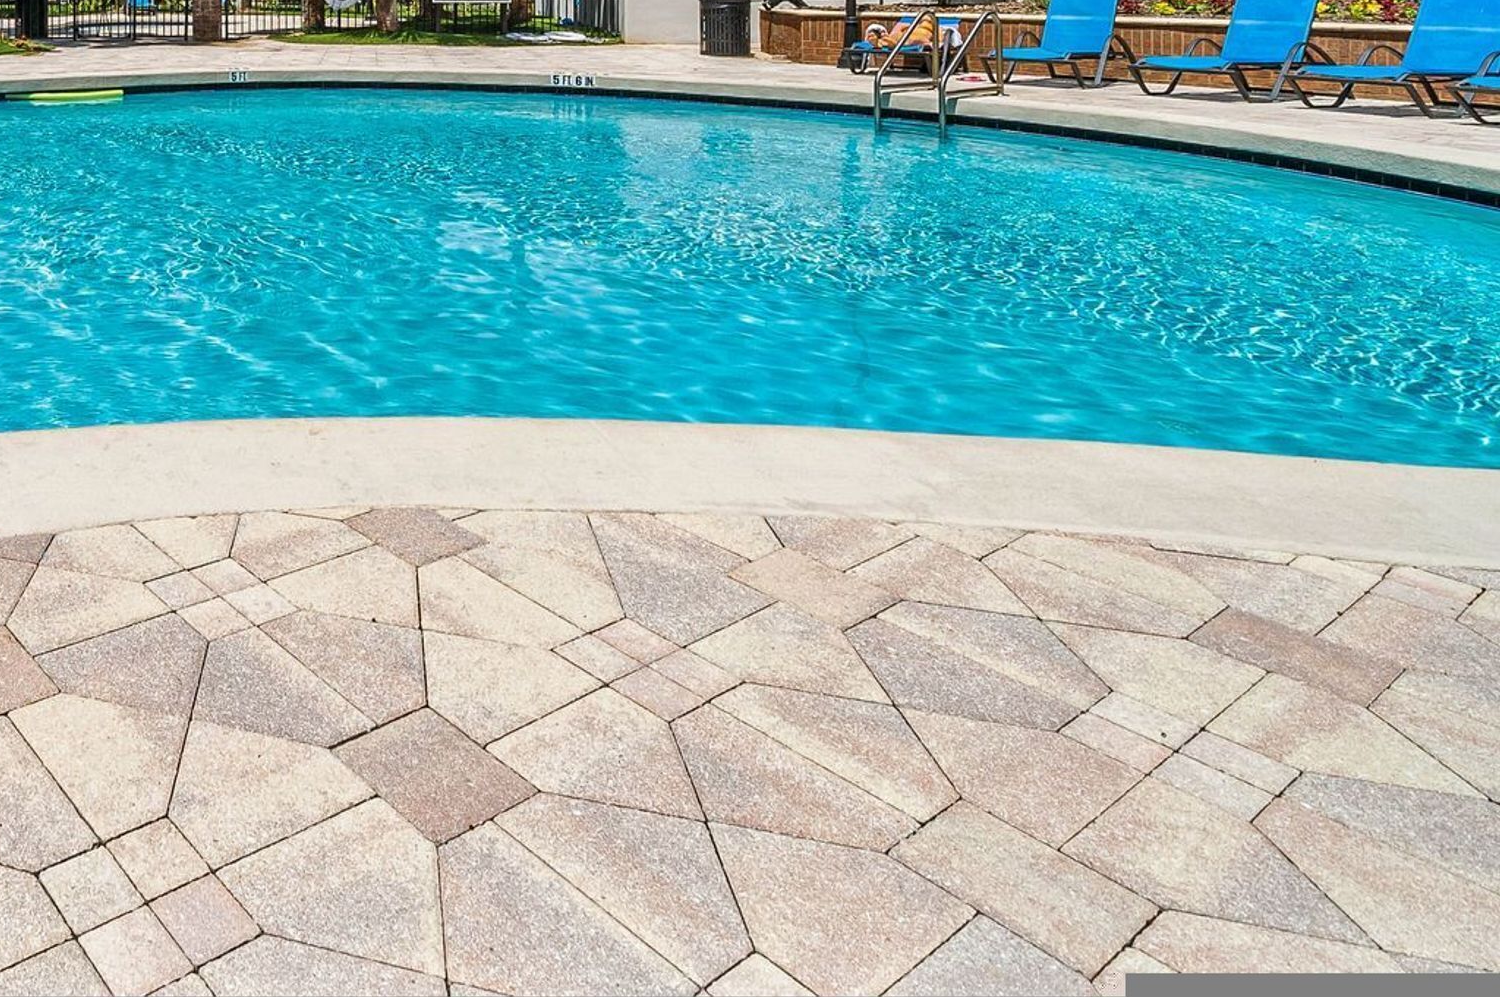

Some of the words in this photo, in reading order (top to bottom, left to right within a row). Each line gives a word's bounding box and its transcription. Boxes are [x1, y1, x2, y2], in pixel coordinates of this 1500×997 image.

[231, 71, 237, 82] 5
[552, 75, 560, 85] 5
[575, 76, 583, 87] 6
